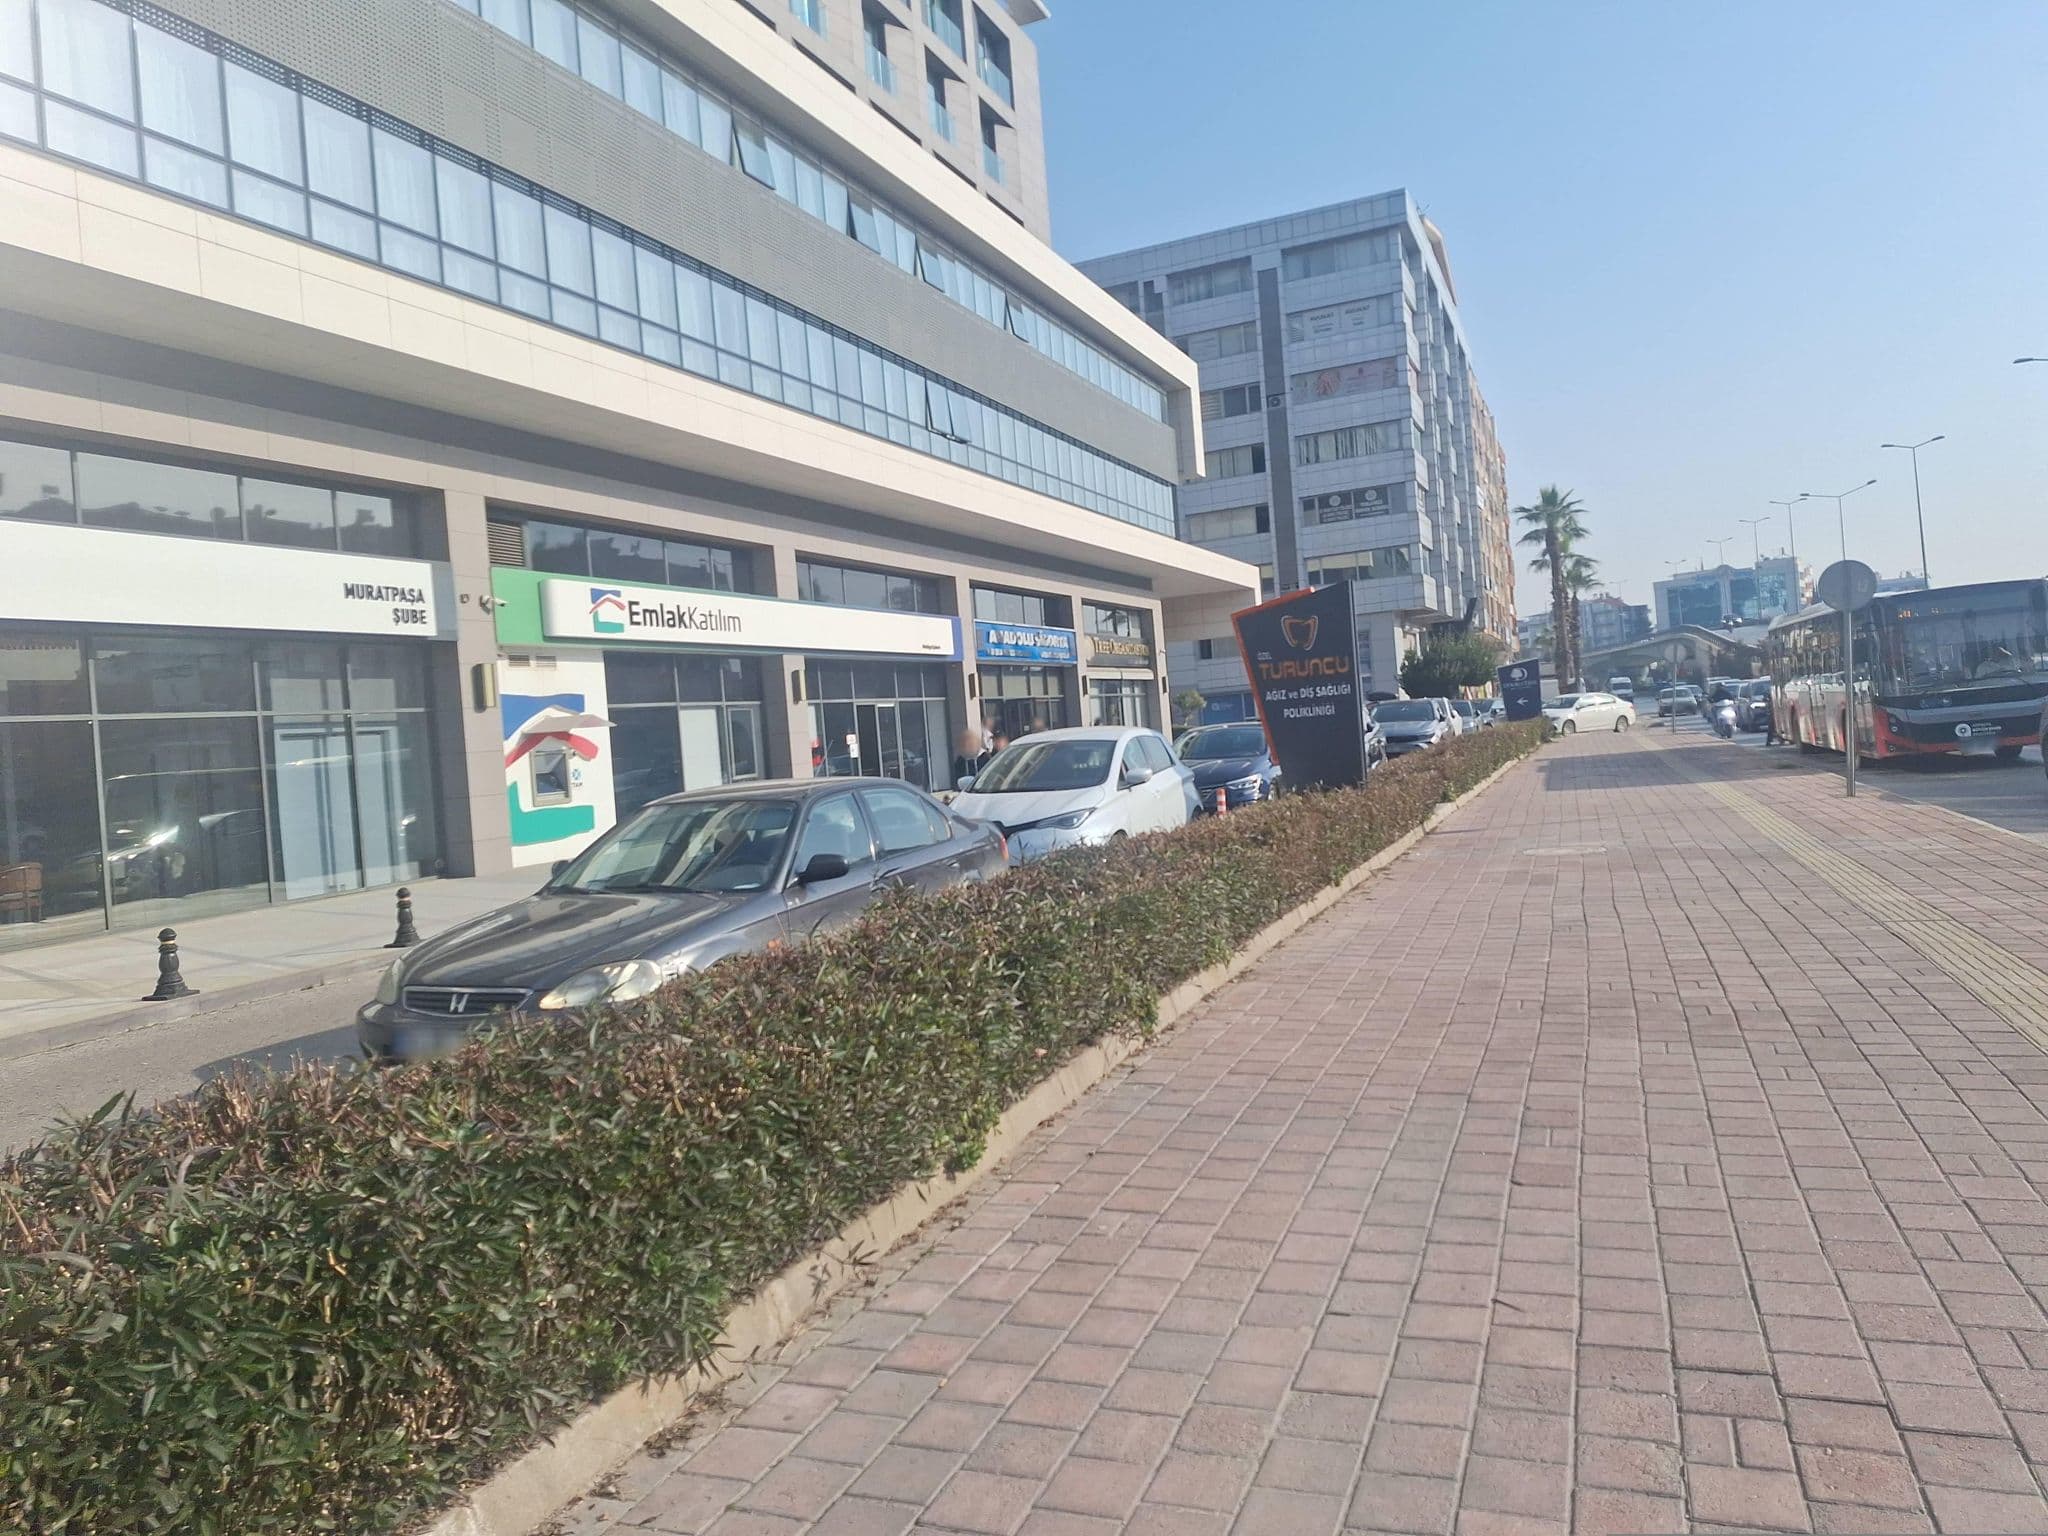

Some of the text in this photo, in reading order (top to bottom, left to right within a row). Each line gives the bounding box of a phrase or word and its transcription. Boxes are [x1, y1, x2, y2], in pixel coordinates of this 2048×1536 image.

[343, 582, 425, 606] MURATPAŞA
[392, 607, 427, 626] ŞUBE
[627, 600, 742, 633] EmlakKatılım
[1259, 655, 1350, 679] TURUNCU
[1288, 691, 1299, 699] ve
